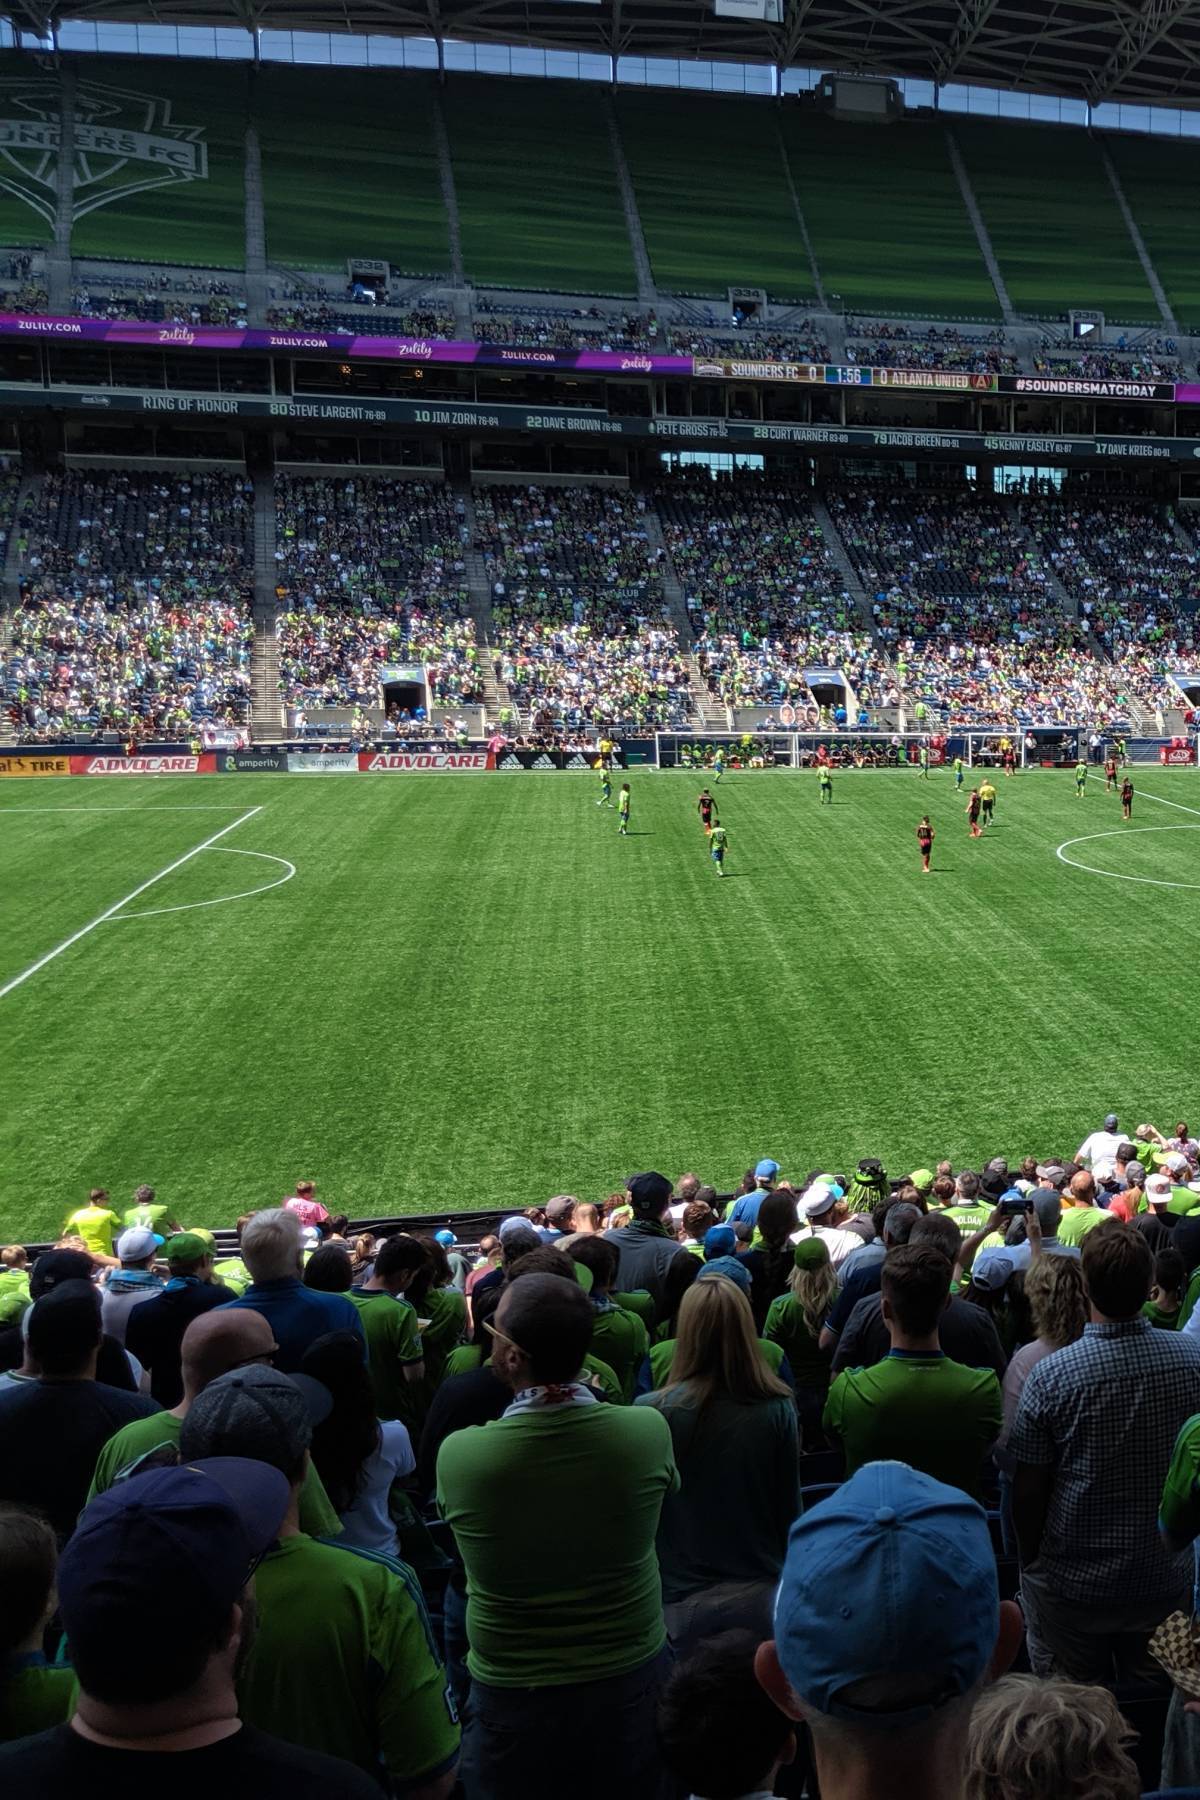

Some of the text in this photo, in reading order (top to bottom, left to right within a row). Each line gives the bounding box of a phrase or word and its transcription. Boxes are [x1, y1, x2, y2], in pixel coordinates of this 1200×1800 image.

[149, 145, 190, 166] FC
[18, 320, 82, 333] ZULILY.COM
[270, 336, 328, 348] ZULILY.COM
[501, 350, 555, 362] ZULILY.COM
[731, 362, 784, 378] SOUNDERS
[785, 365, 799, 380] FC
[809, 366, 817, 381] 0
[836, 368, 861, 384] 1:56
[879, 369, 888, 385] 0
[891, 372, 969, 388] ATLANTA UNITED
[1016, 378, 1156, 397] #SOUNDERSMATCHDAY
[143, 397, 238, 413] RING OF HONOR
[270, 403, 386, 421] 80 STEVE LARGENT 76-89
[415, 410, 499, 426] 10 JIM ZORN 76-84
[526, 415, 542, 427] 22
[543, 416, 565, 430] DAVE
[567, 418, 601, 431] BROWN
[656, 423, 678, 435] PETE
[679, 424, 708, 436] GROSS
[754, 427, 769, 438] 28
[769, 428, 791, 440] CURT
[793, 429, 829, 442] WARNER
[874, 433, 887, 445] 79
[888, 434, 913, 446] JACOB
[914, 435, 941, 447] GREEN
[984, 439, 999, 450] 45
[1000, 439, 1025, 451] KENNY
[1026, 441, 1055, 452] EASLEY
[1095, 443, 1107, 454] 17
[1108, 443, 1127, 455] DAVE
[1129, 444, 1153, 456] KRIEG
[30, 761, 65, 771] TIRE
[90, 757, 197, 772] ADVOCARE
[239, 758, 280, 769] amperity
[311, 759, 350, 769] amperity
[371, 755, 486, 769] ADVOCARE
